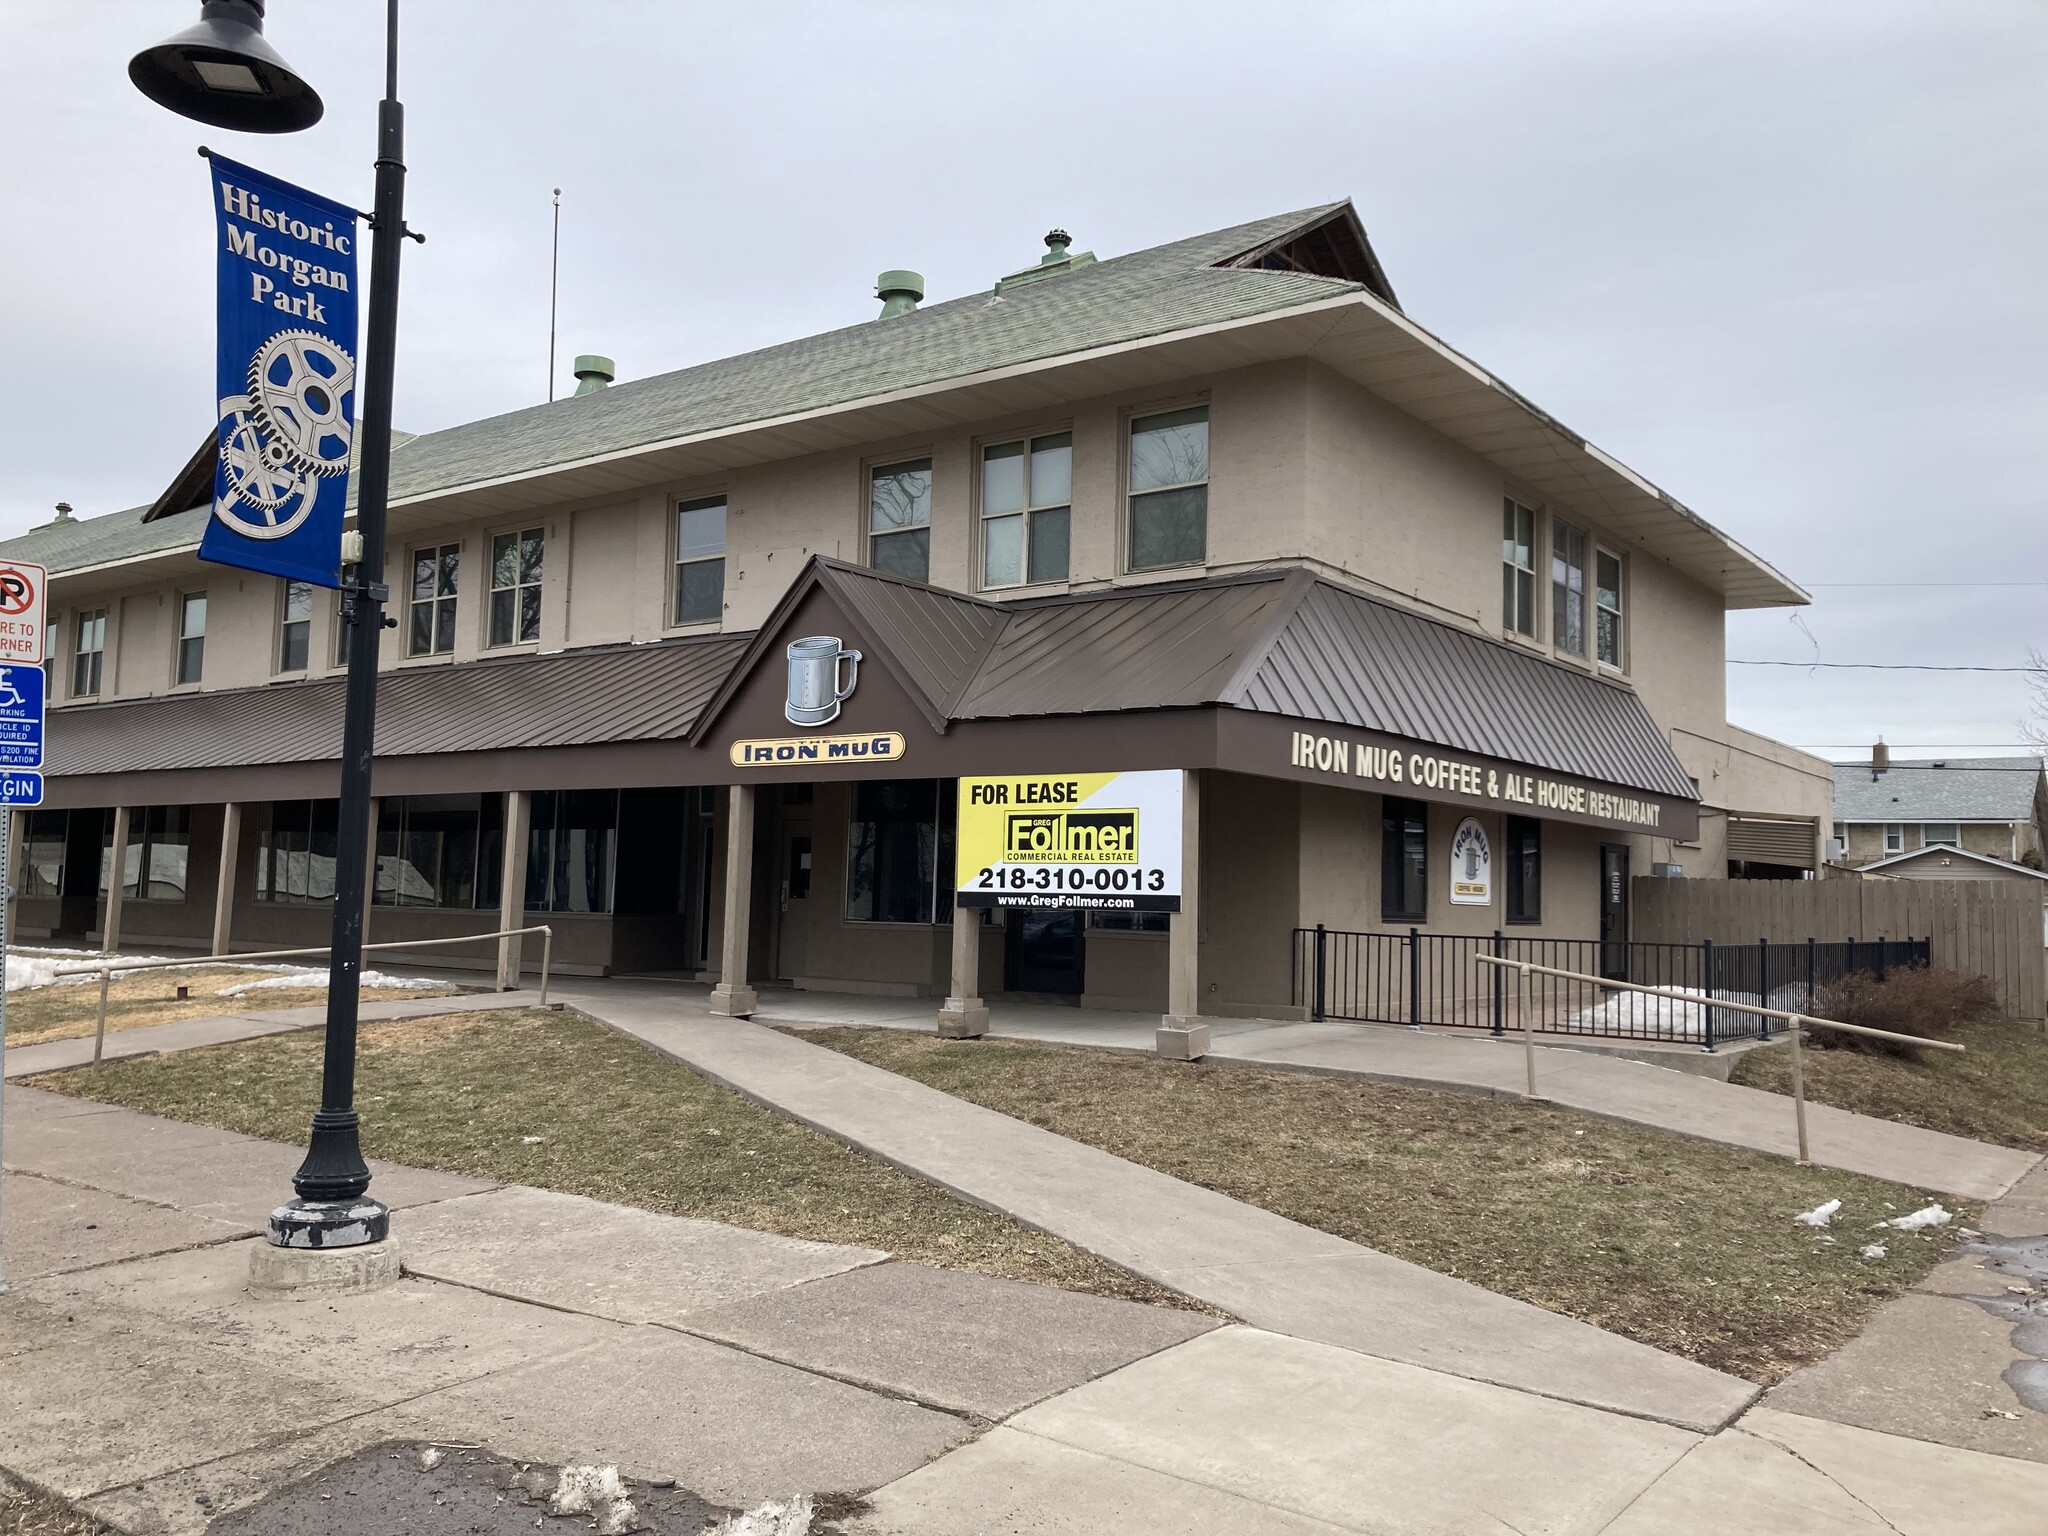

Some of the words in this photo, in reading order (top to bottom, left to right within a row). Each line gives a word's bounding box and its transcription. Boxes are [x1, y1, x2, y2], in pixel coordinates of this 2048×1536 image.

[220, 181, 350, 255] Historic
[226, 222, 349, 292] Morgan
[251, 272, 327, 324] Park
[0, 621, 15, 634] RE
[19, 623, 34, 636] TO
[0, 638, 33, 652] RNER
[0, 708, 25, 717] RKING
[0, 723, 18, 731] ICLE
[22, 724, 31, 732] ID
[0, 746, 20, 755] $200
[24, 747, 39, 755] FINE
[744, 744, 818, 762] IRON
[828, 737, 891, 758] MUG
[1291, 731, 1348, 774] IRON
[1355, 744, 1403, 782] MUG
[1409, 753, 1482, 796] COFFEE
[1487, 769, 1499, 799] &
[1504, 773, 1533, 805] ALE
[0, 780, 33, 797] GIN
[971, 784, 1008, 805] FOR
[1015, 781, 1078, 804] LEASE
[1011, 813, 1132, 851] Follmer
[1007, 852, 1068, 861] COMMERCIAL
[1071, 852, 1095, 861] REAL
[1098, 852, 1134, 861] ESTATE
[1454, 826, 1472, 859] IRON
[1475, 828, 1489, 864] MUG
[978, 867, 1165, 891] 218-310-0013
[998, 894, 1135, 908] www.GregFollmer.com
